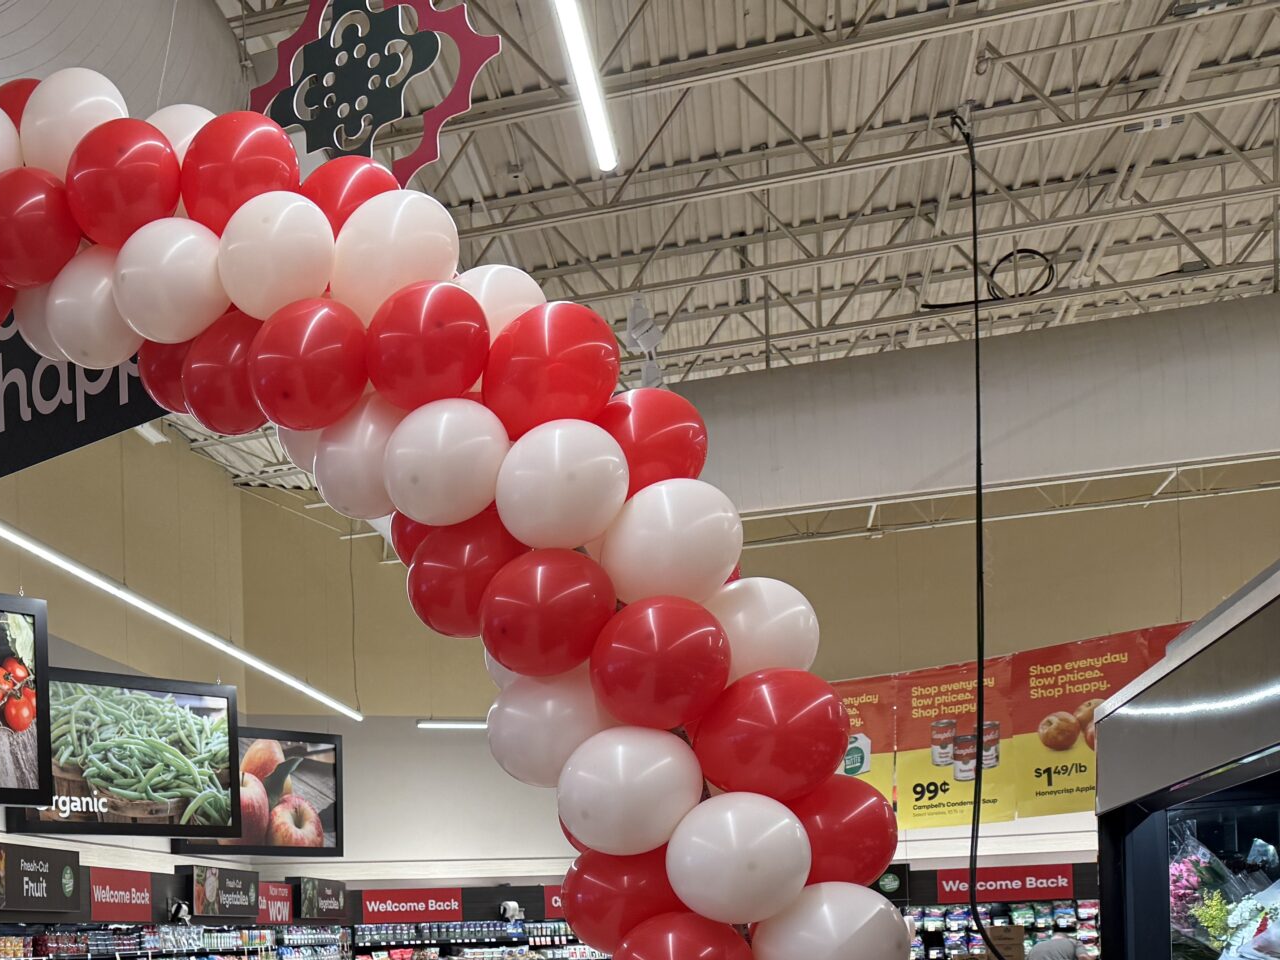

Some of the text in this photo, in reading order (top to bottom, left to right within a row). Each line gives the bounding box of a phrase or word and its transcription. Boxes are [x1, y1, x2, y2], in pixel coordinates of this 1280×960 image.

[1029, 652, 1128, 676] Shop everyday
[1029, 669, 1104, 688] low prices.
[911, 684, 939, 697] Shop
[1030, 680, 1111, 699] Shop happy.
[911, 693, 974, 708] low prices.
[911, 707, 939, 719] Shop
[912, 780, 951, 802] 99¢
[1035, 788, 1074, 797] Honeycrisp
[36, 790, 108, 818] rganic
[20, 858, 49, 873] Fresh-Cut
[23, 876, 47, 898] Fruit
[942, 875, 1068, 892] Wecome Back
[92, 885, 150, 905] Welcome Back
[218, 889, 248, 909] Vegetables
[268, 900, 290, 922] WOW
[366, 898, 459, 913] Welcome Back
